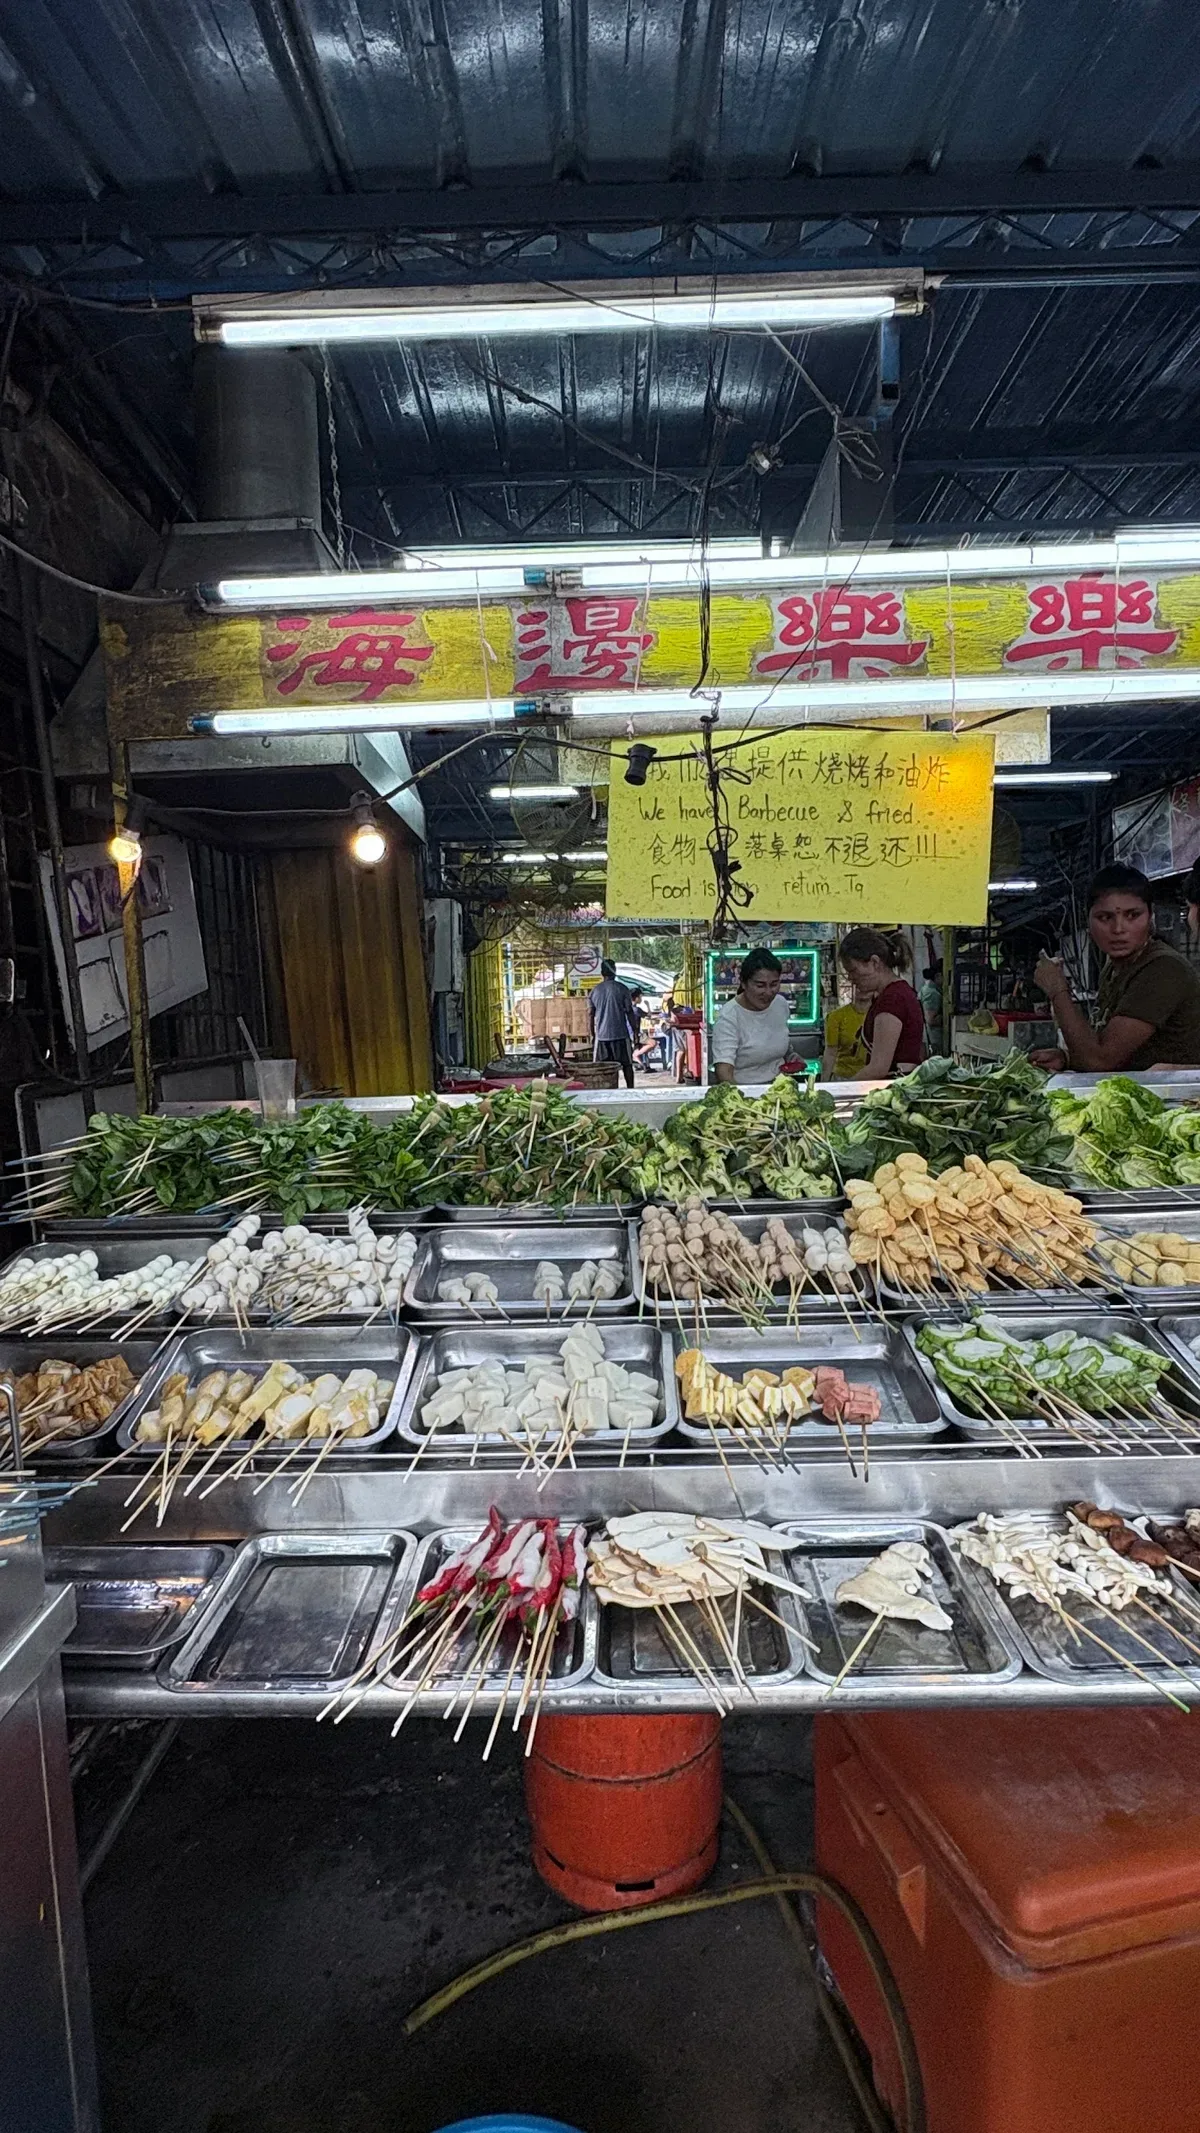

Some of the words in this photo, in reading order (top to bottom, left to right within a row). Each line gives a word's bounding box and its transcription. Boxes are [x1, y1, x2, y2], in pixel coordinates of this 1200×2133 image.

[639, 797, 666, 821] We
[679, 796, 714, 820] have
[738, 794, 819, 822] Barbecue
[838, 800, 854, 823] &
[651, 873, 691, 899] Food
[702, 880, 717, 897] is
